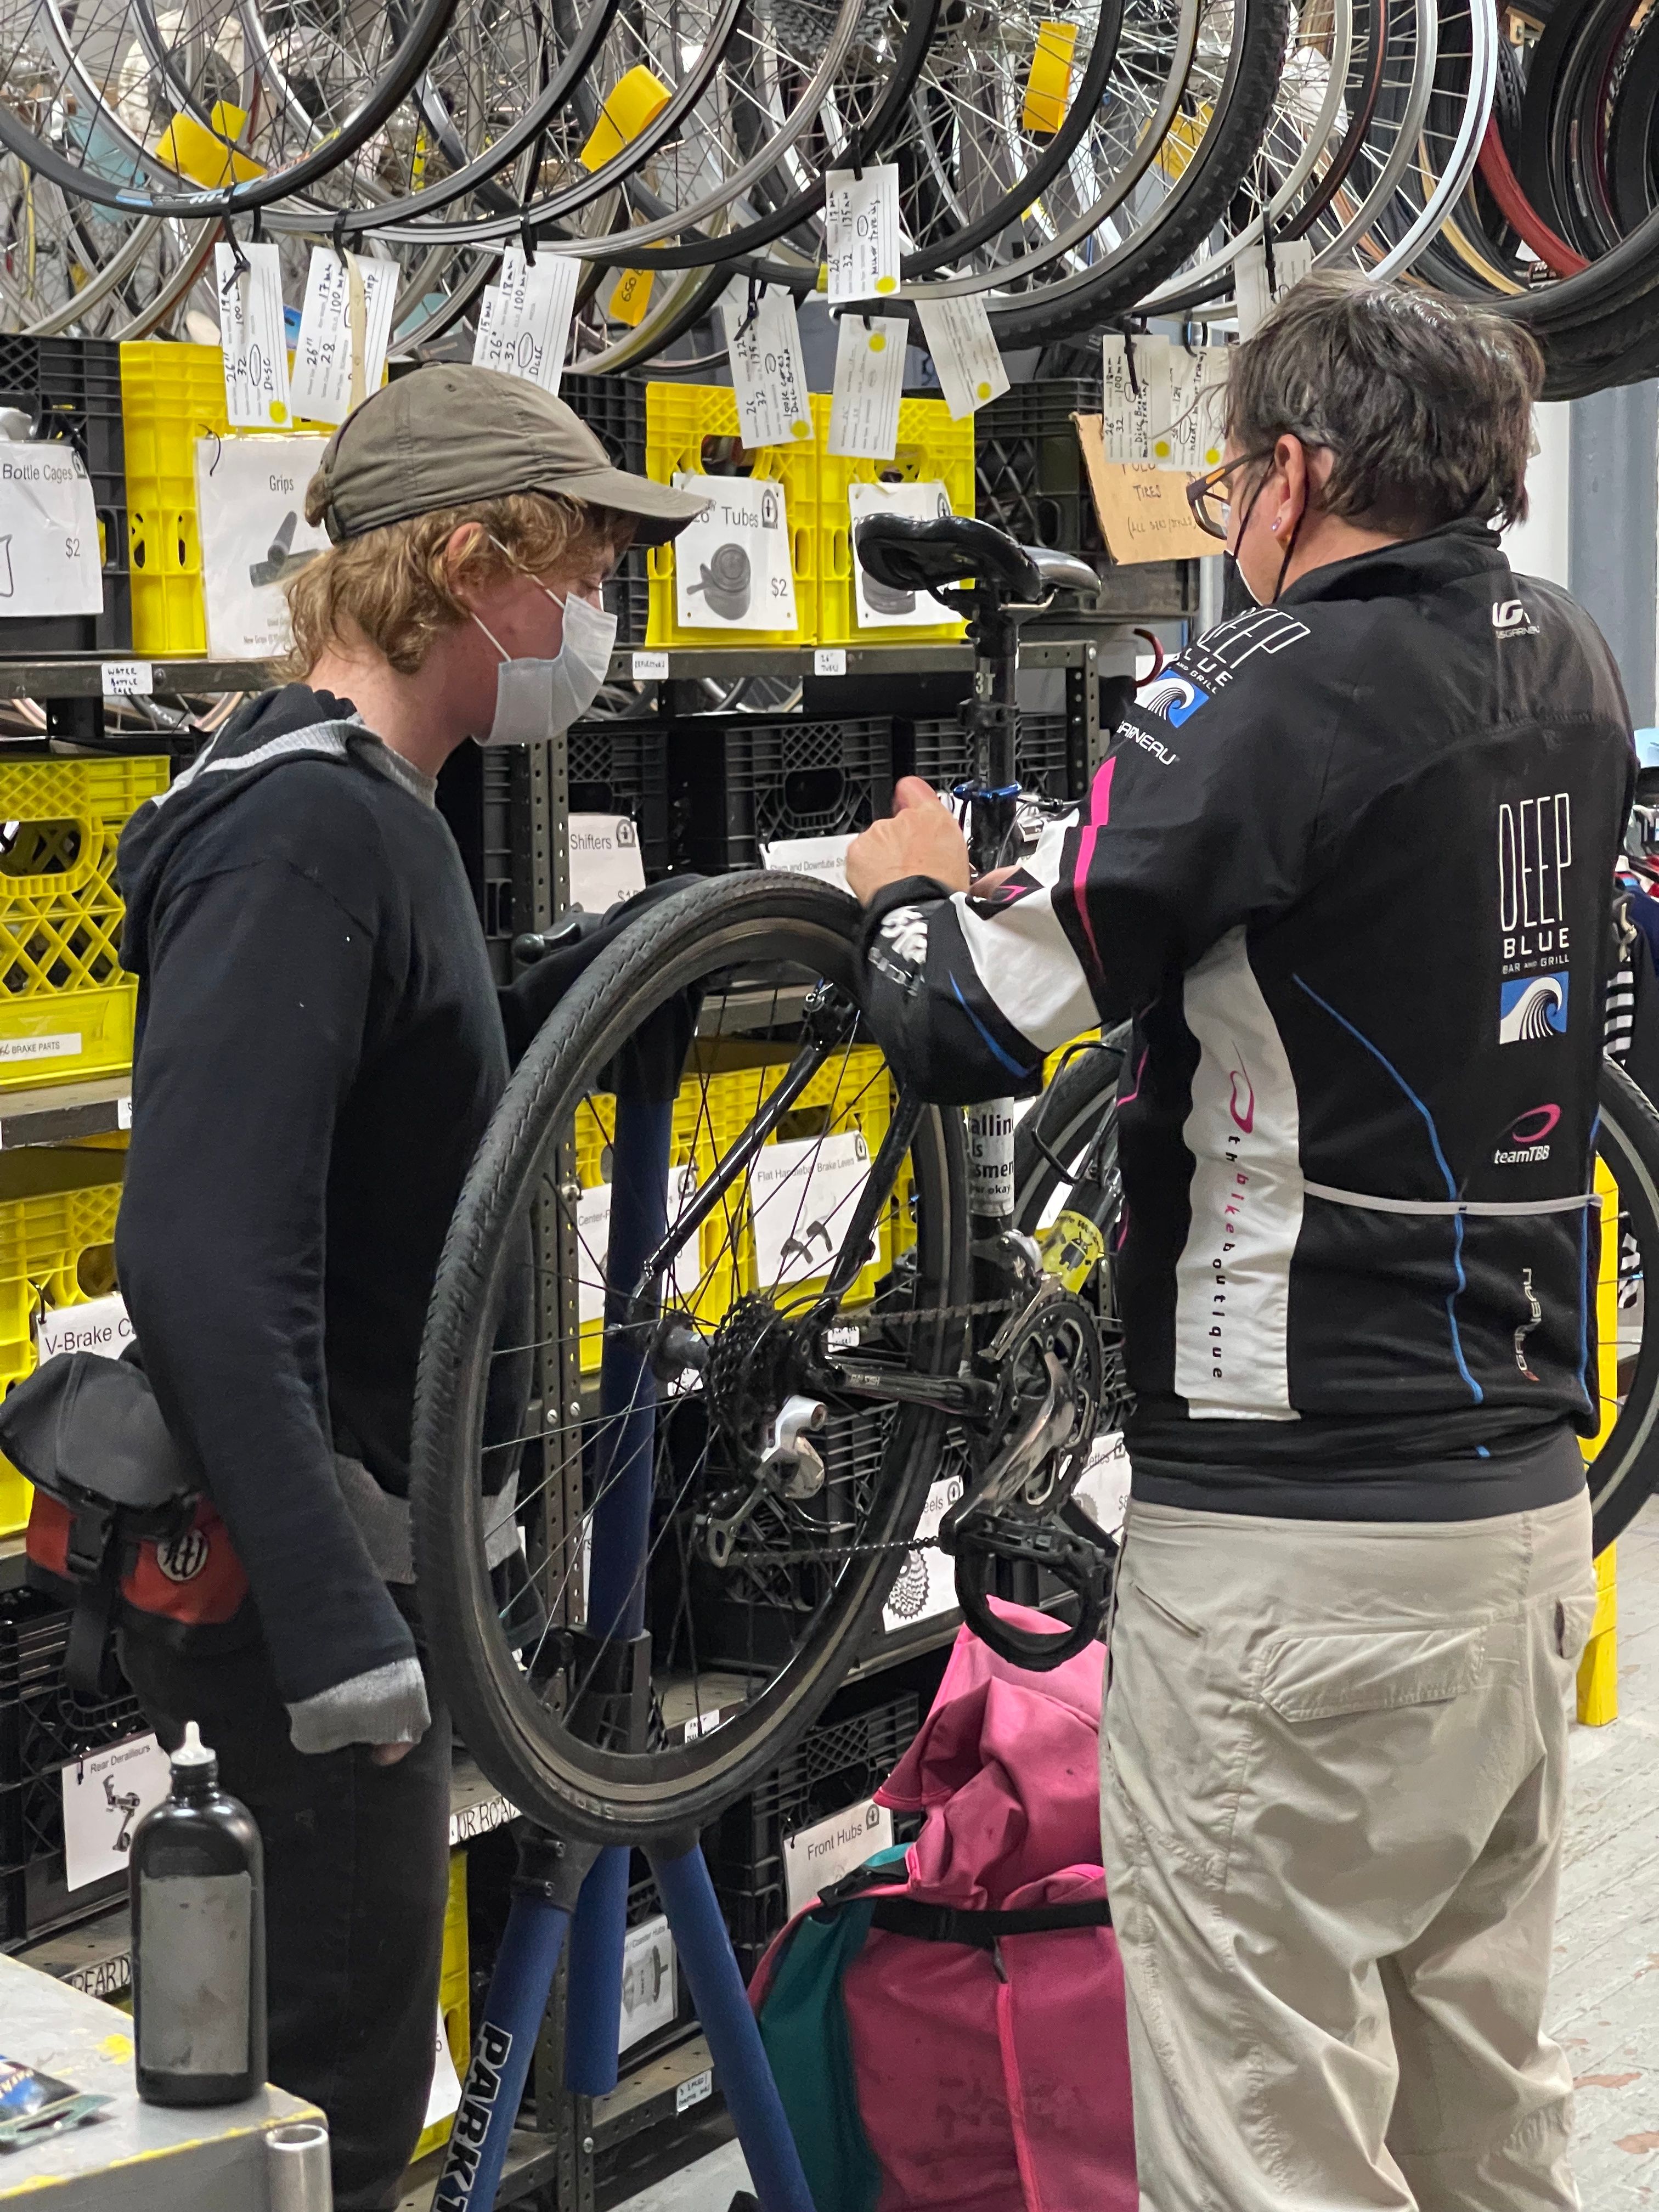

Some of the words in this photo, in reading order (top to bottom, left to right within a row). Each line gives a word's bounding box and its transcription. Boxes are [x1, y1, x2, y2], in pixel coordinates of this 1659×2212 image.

[321, 343, 335, 364] 28
[505, 341, 516, 360] 32
[238, 357, 246, 376] 32
[758, 390, 767, 406] 32
[1116, 417, 1124, 433] 32
[3, 463, 40, 480] Bottle
[44, 465, 72, 484] Cages
[269, 475, 294, 494] Grips
[721, 506, 759, 527] Tubes
[65, 537, 81, 559] $2
[771, 577, 788, 598] $2
[570, 834, 612, 850] Shifters
[1499, 793, 1571, 932] DEEP
[1503, 927, 1570, 959] BLUE
[1502, 962, 1520, 974] BAR
[1541, 954, 1569, 967] GRILL
[12, 1043, 37, 1054] BRAKE
[38, 1041, 60, 1052] PARTS
[758, 1170, 772, 1182] Flat
[817, 1161, 837, 1172] Brake
[837, 1158, 855, 1169] Levers
[1208, 1242, 1236, 1379] boutique
[45, 1325, 112, 1355] V-Brake
[91, 1760, 109, 1774] Rear
[111, 1745, 150, 1766] Derailleurs
[808, 1835, 834, 1860] Front
[837, 1824, 862, 1846] Hubs
[444, 2022, 513, 2192] PARK
